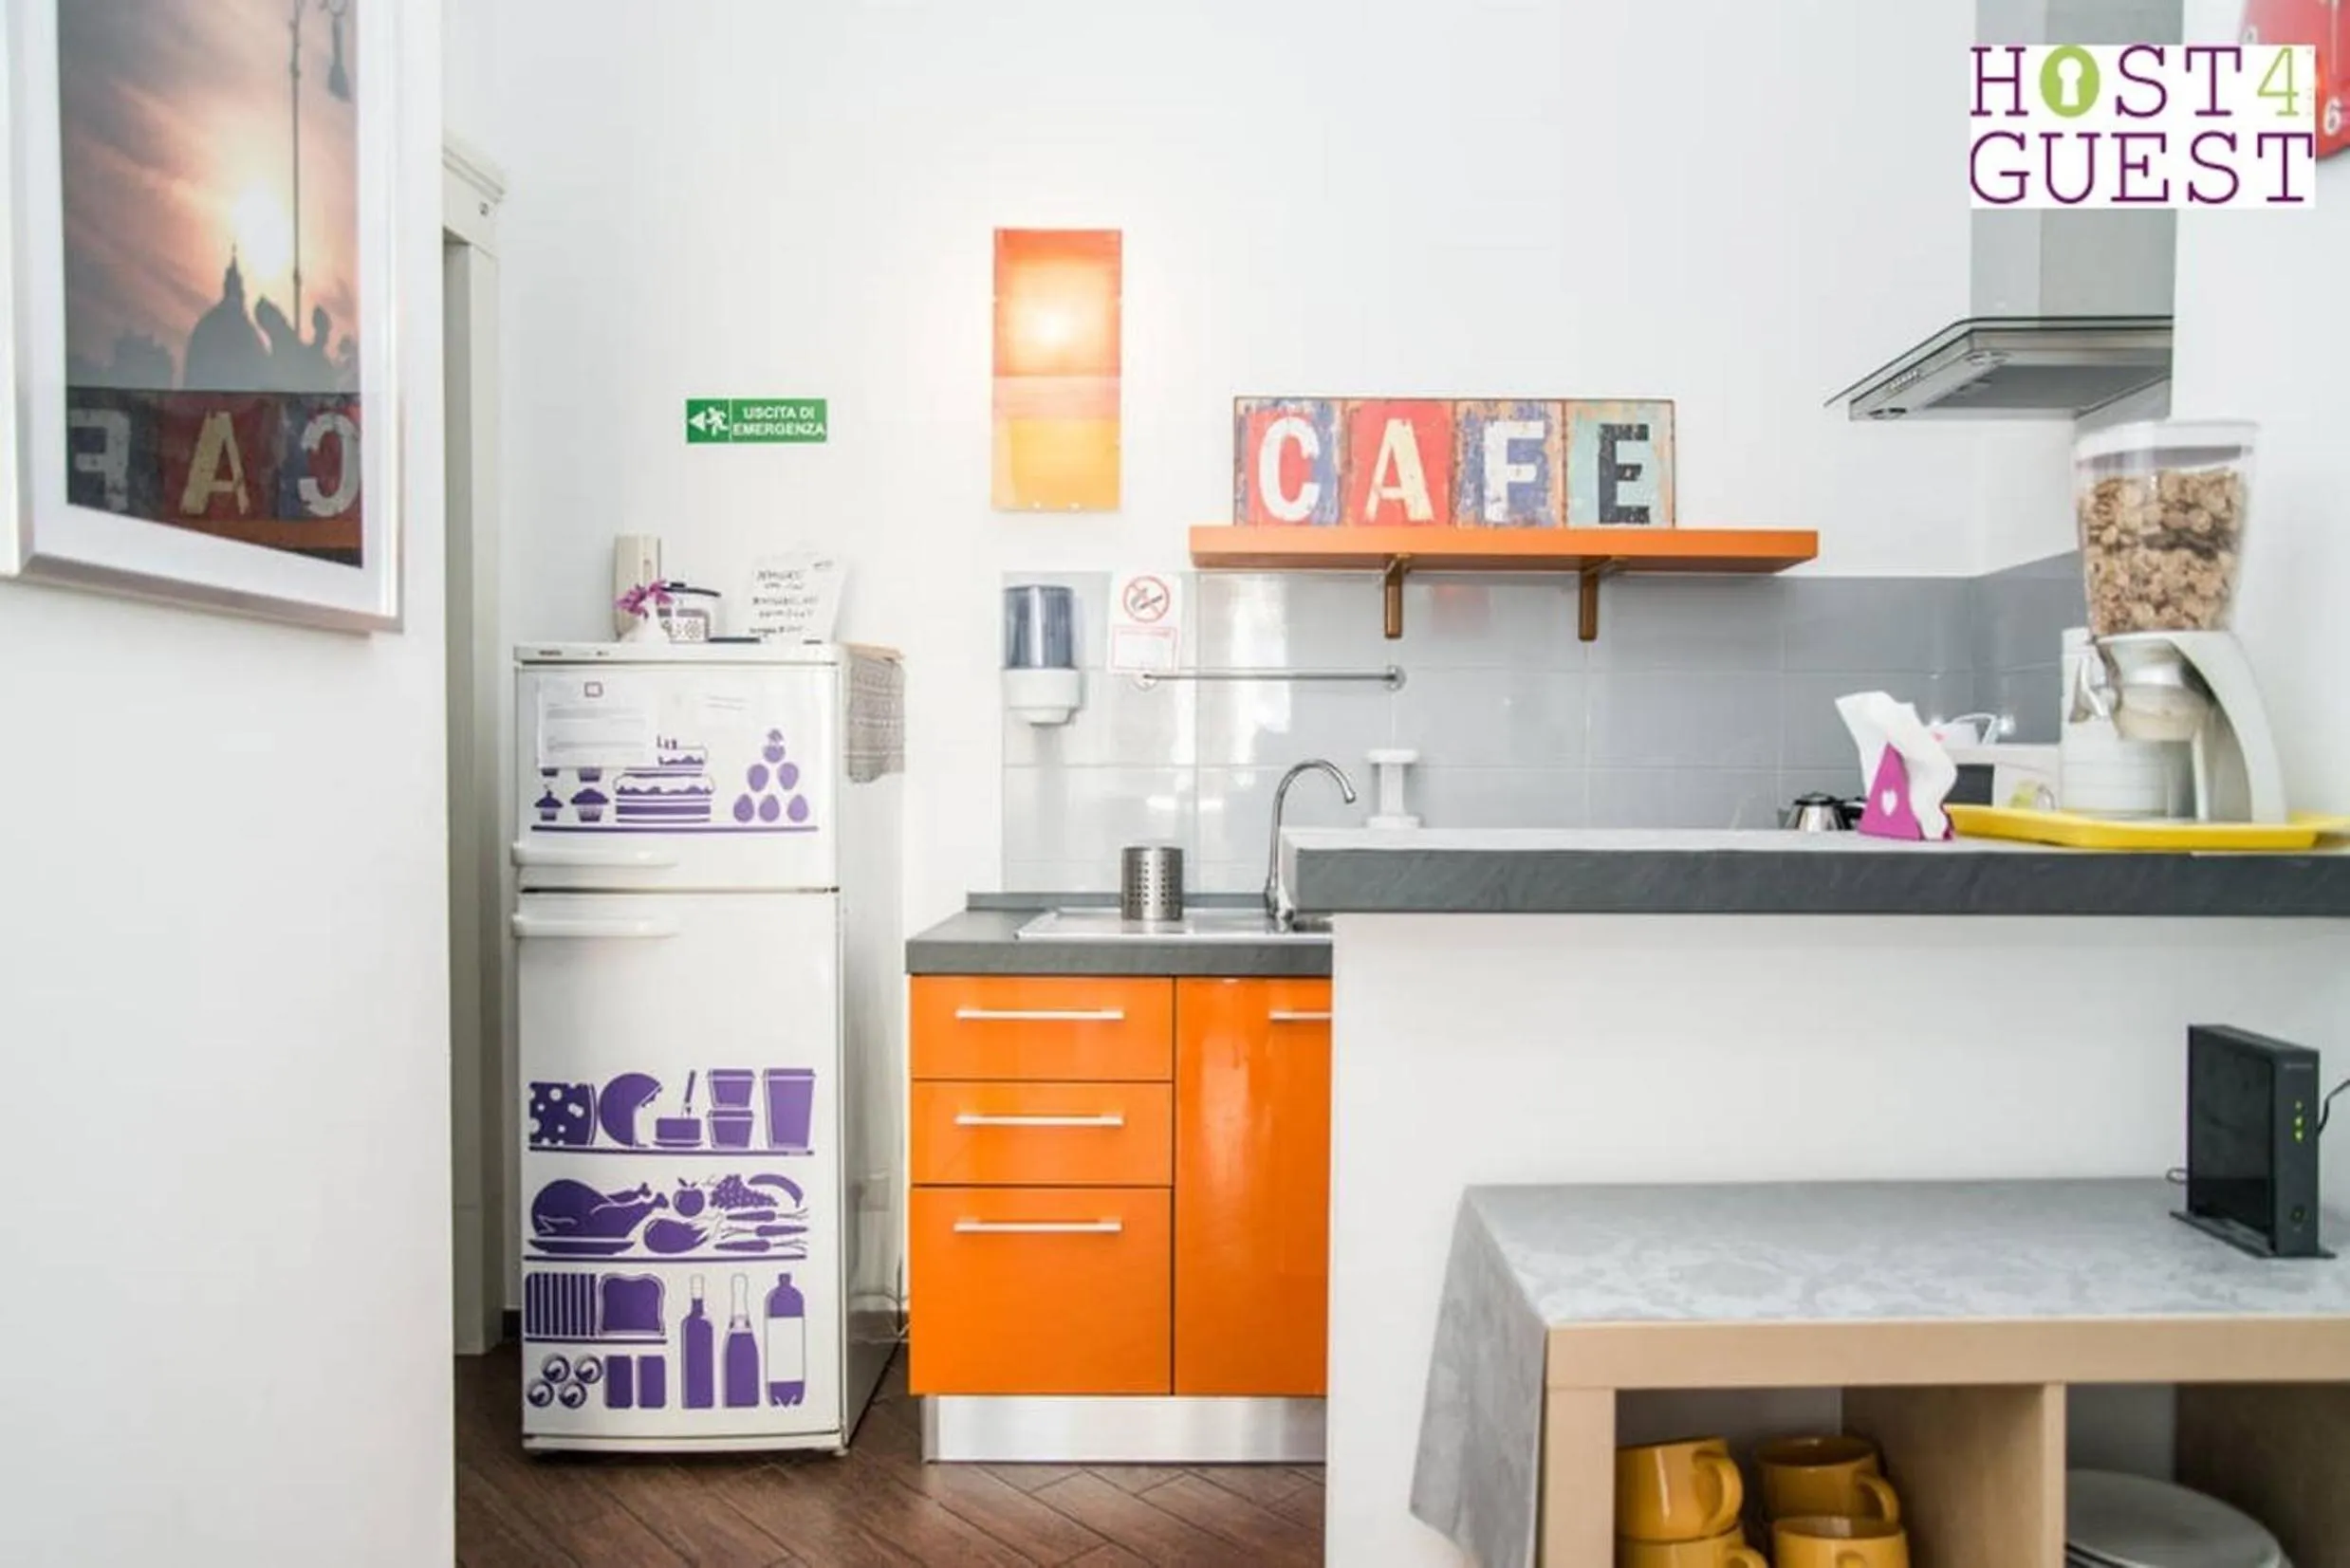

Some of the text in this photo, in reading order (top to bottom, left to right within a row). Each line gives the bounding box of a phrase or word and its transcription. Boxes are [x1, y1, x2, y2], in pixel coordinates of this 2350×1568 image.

[2323, 97, 2341, 136] 6
[743, 406, 815, 419] USCITA DI
[733, 422, 825, 436] EMERGENZA
[1258, 416, 1650, 525] CAFE
